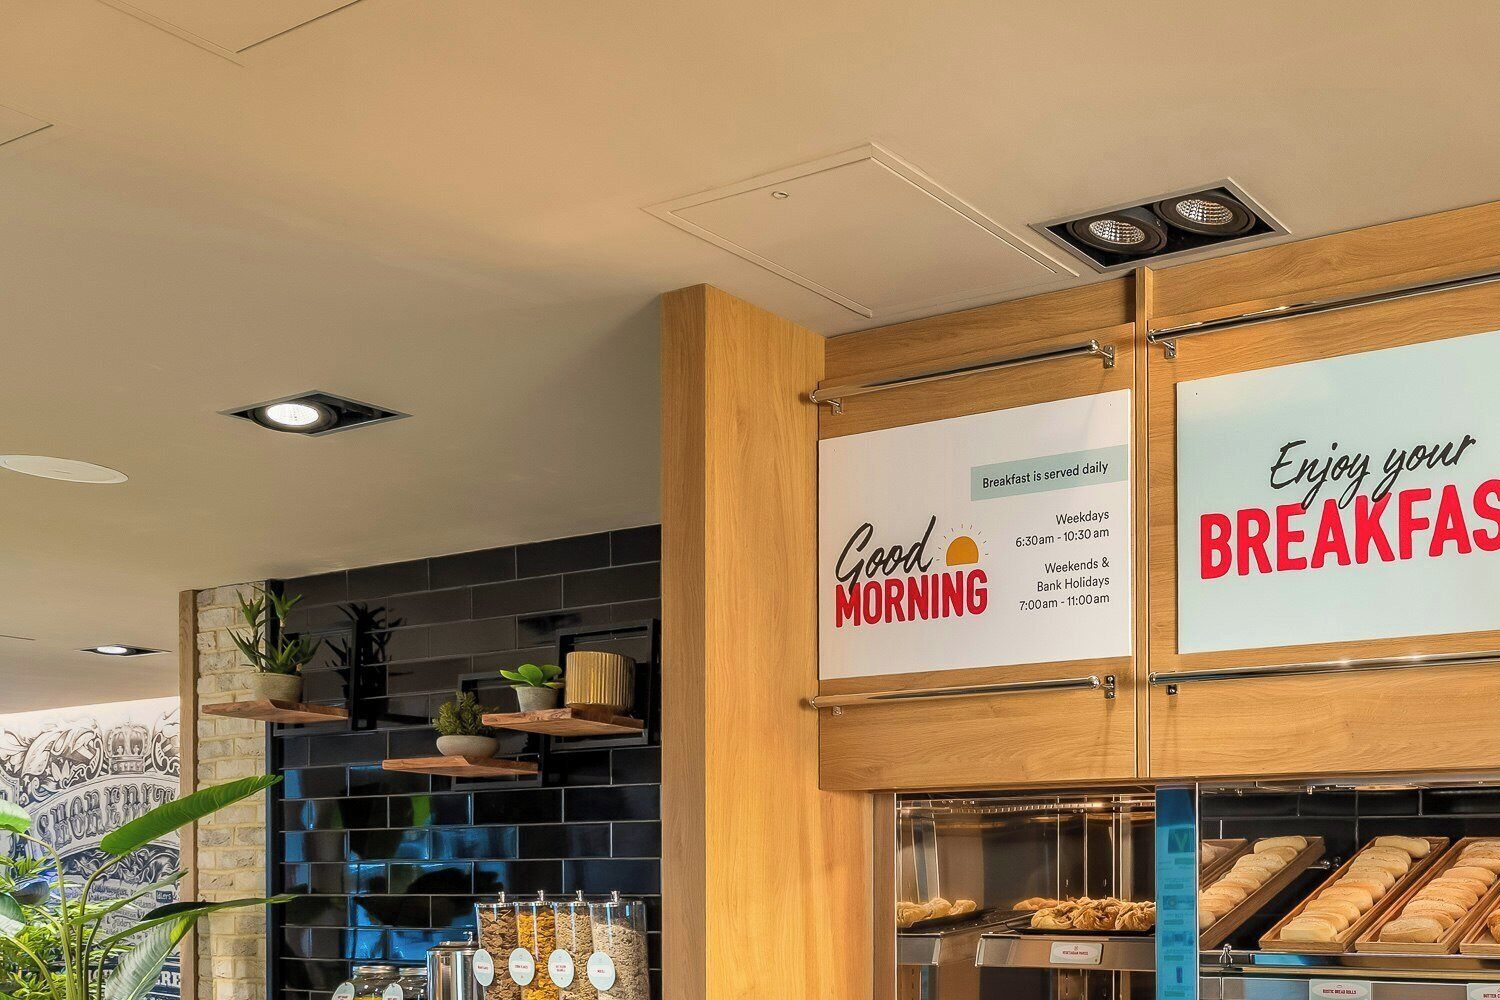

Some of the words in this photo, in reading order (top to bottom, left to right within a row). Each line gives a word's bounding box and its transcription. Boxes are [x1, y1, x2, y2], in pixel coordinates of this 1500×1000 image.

[983, 473, 1030, 488] Breakfast
[1034, 471, 1041, 481] is
[1045, 465, 1079, 480] served
[1083, 461, 1108, 478] daily
[1270, 440, 1369, 509] Enjoy
[1372, 435, 1475, 502] your
[1056, 510, 1109, 525] Weekdays
[835, 515, 936, 595] Good
[1045, 558, 1098, 573] Weekends
[1102, 557, 1109, 567] &
[1038, 580, 1061, 591] Bank
[1065, 576, 1109, 589] Holidays
[835, 569, 988, 627] MORNING
